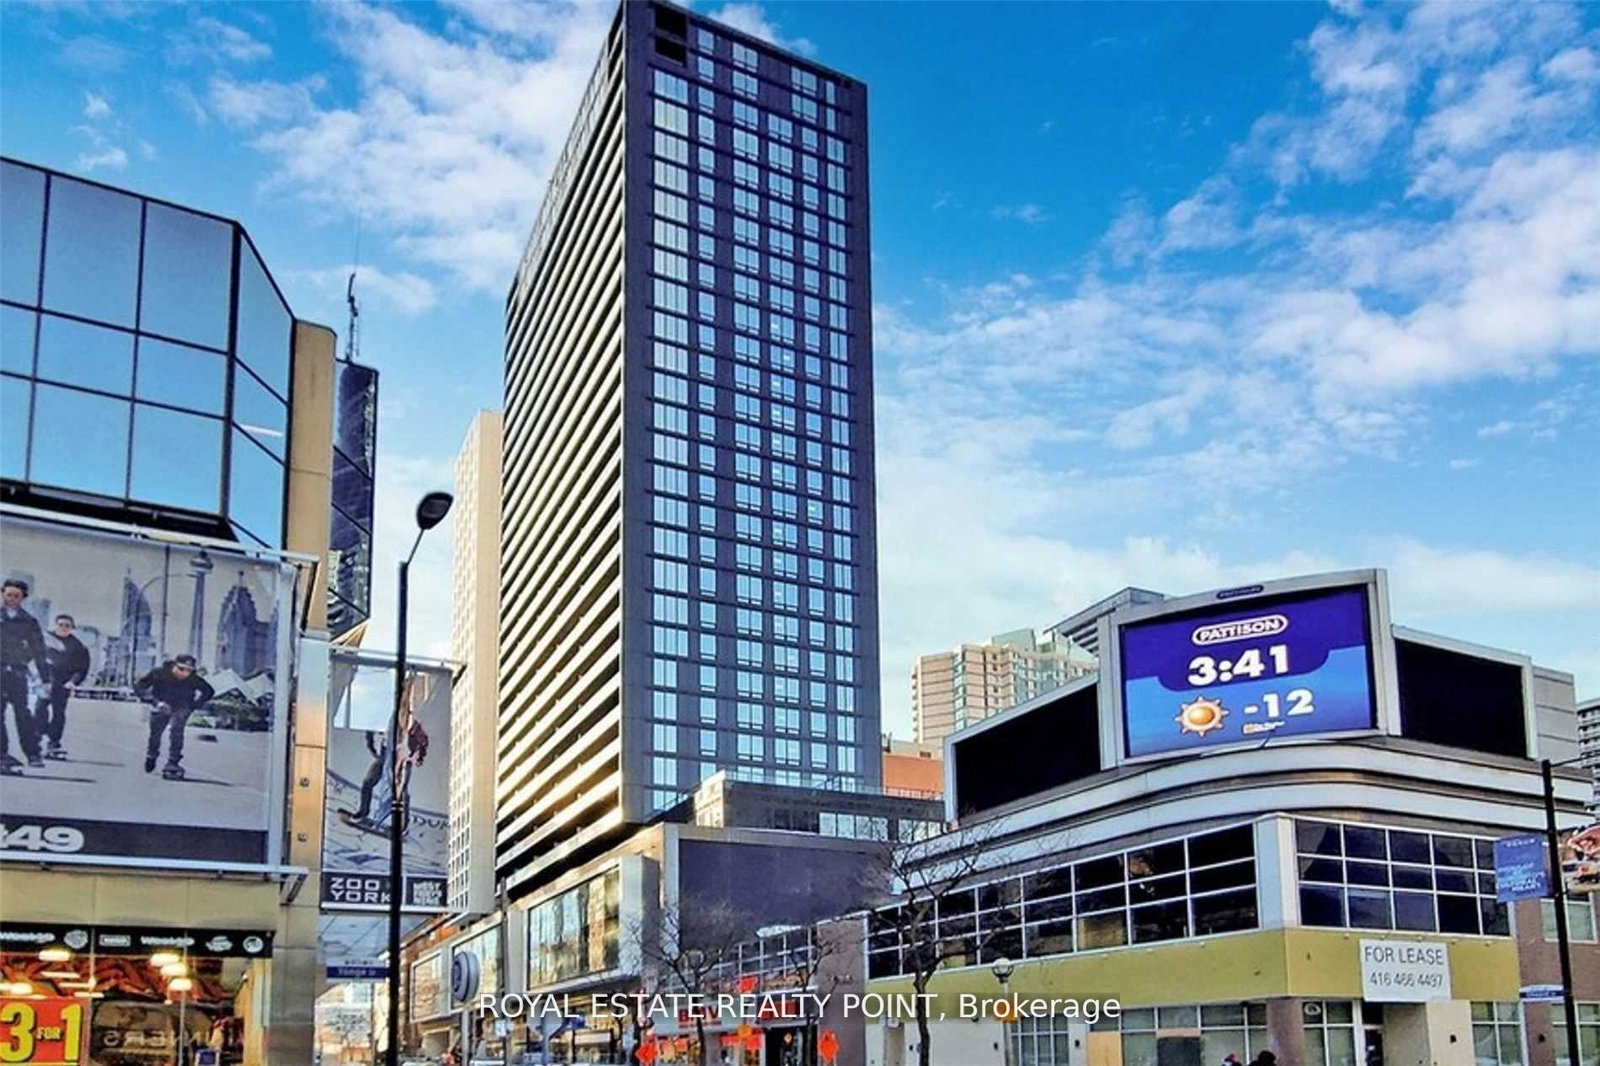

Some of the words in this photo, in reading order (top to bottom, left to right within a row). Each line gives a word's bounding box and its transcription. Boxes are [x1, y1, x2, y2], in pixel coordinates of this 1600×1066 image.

[1199, 618, 1280, 642] PATTISON
[1187, 644, 1289, 686] 3:41
[1243, 688, 1315, 718] -12
[330, 877, 380, 891] ZOO
[330, 889, 391, 903] YORK
[1364, 945, 1394, 963] FOR
[1398, 947, 1444, 966] LEASE
[1369, 971, 1392, 987] 416
[0, 1002, 35, 1063] 3
[37, 1026, 61, 1040] FOR
[60, 1003, 81, 1061] 1
